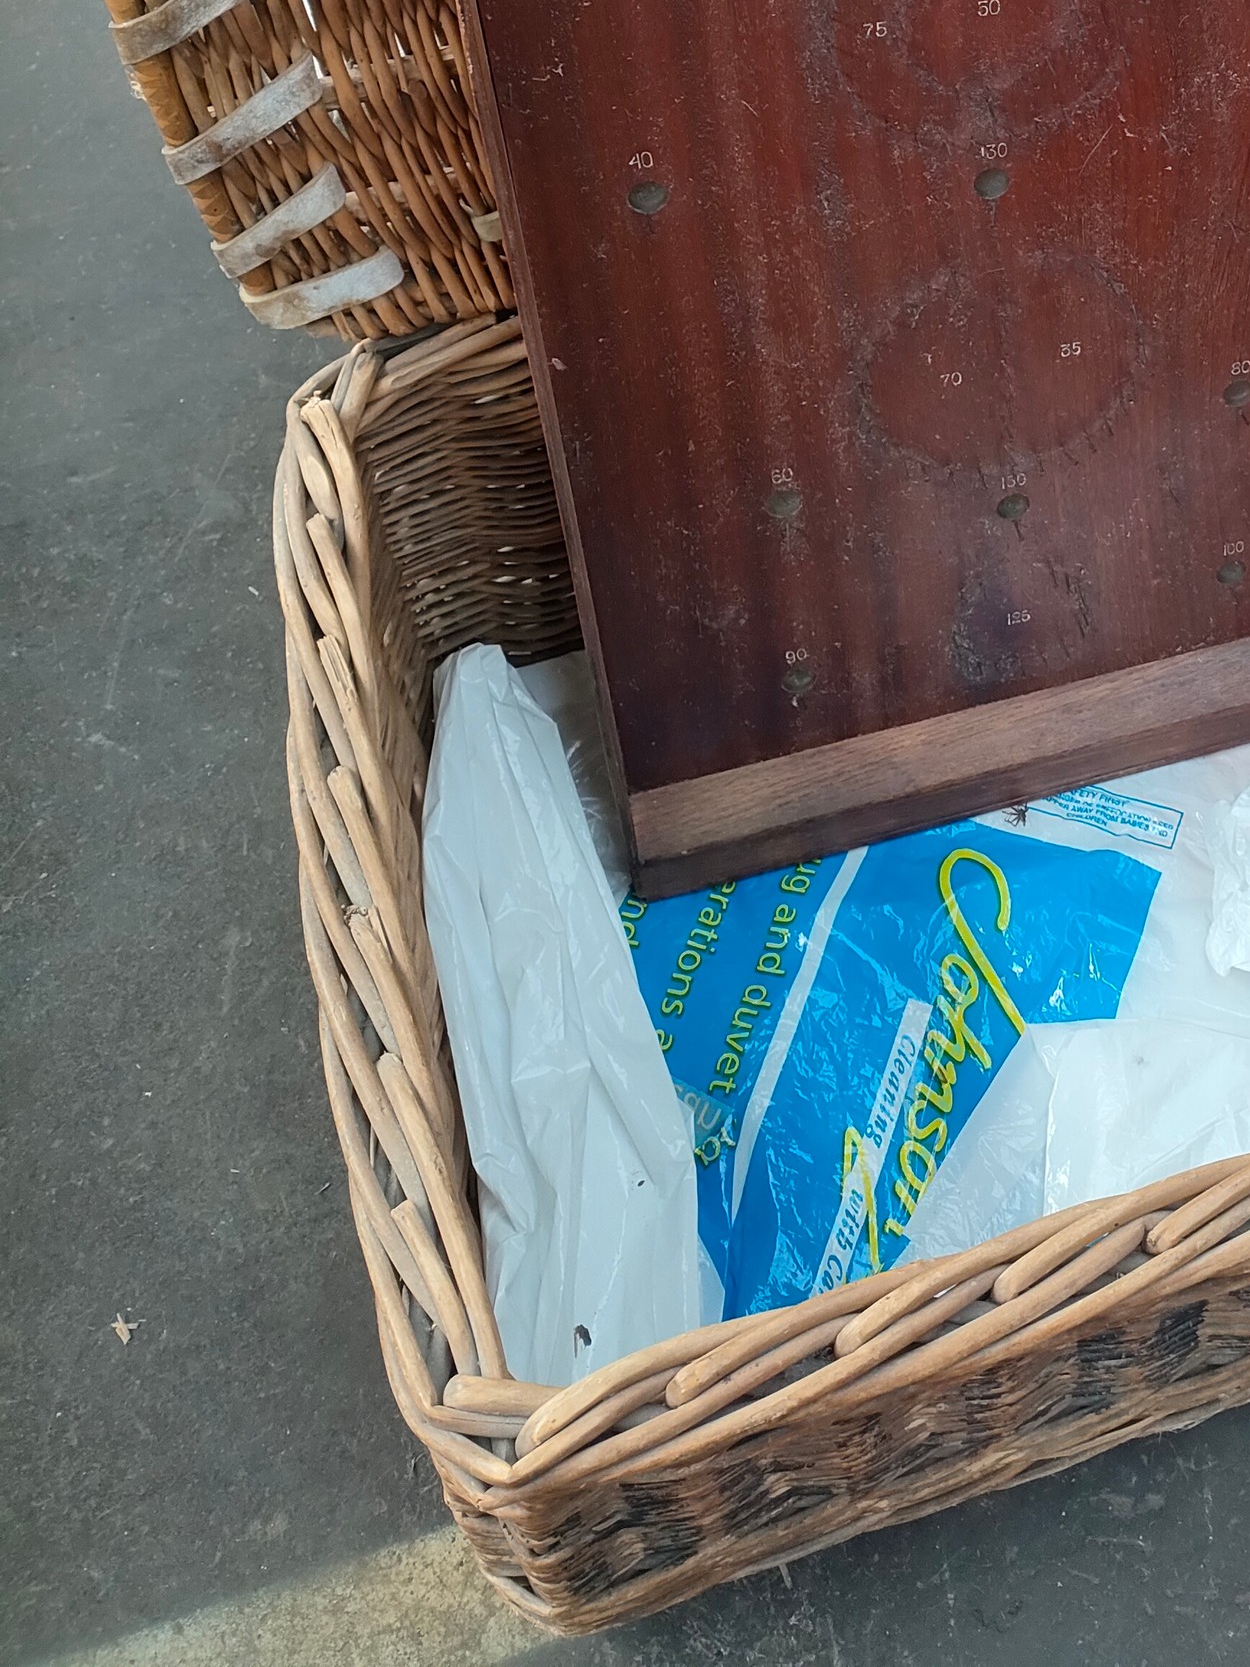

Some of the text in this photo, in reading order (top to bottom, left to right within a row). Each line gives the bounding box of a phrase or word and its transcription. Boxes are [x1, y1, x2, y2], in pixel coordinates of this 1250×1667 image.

[862, 21, 887, 39] 75
[628, 151, 654, 170] 40
[1060, 341, 1082, 358] 35
[1231, 360, 1250, 375] 80
[939, 372, 962, 388] 70
[771, 467, 794, 485] 60
[1223, 541, 1245, 556] 100
[1007, 610, 1031, 626] 125
[785, 648, 807, 665] 90
[1071, 788, 1127, 806] AFETY FIRST
[1071, 805, 1093, 813] AWAY
[1096, 808, 1119, 823] FROM
[1120, 817, 1149, 831] BABIES
[619, 888, 649, 950] nd
[660, 877, 738, 1023] erations
[709, 858, 824, 1096] ug and duvet
[809, 1031, 916, 1298] Cleaning with Ca
